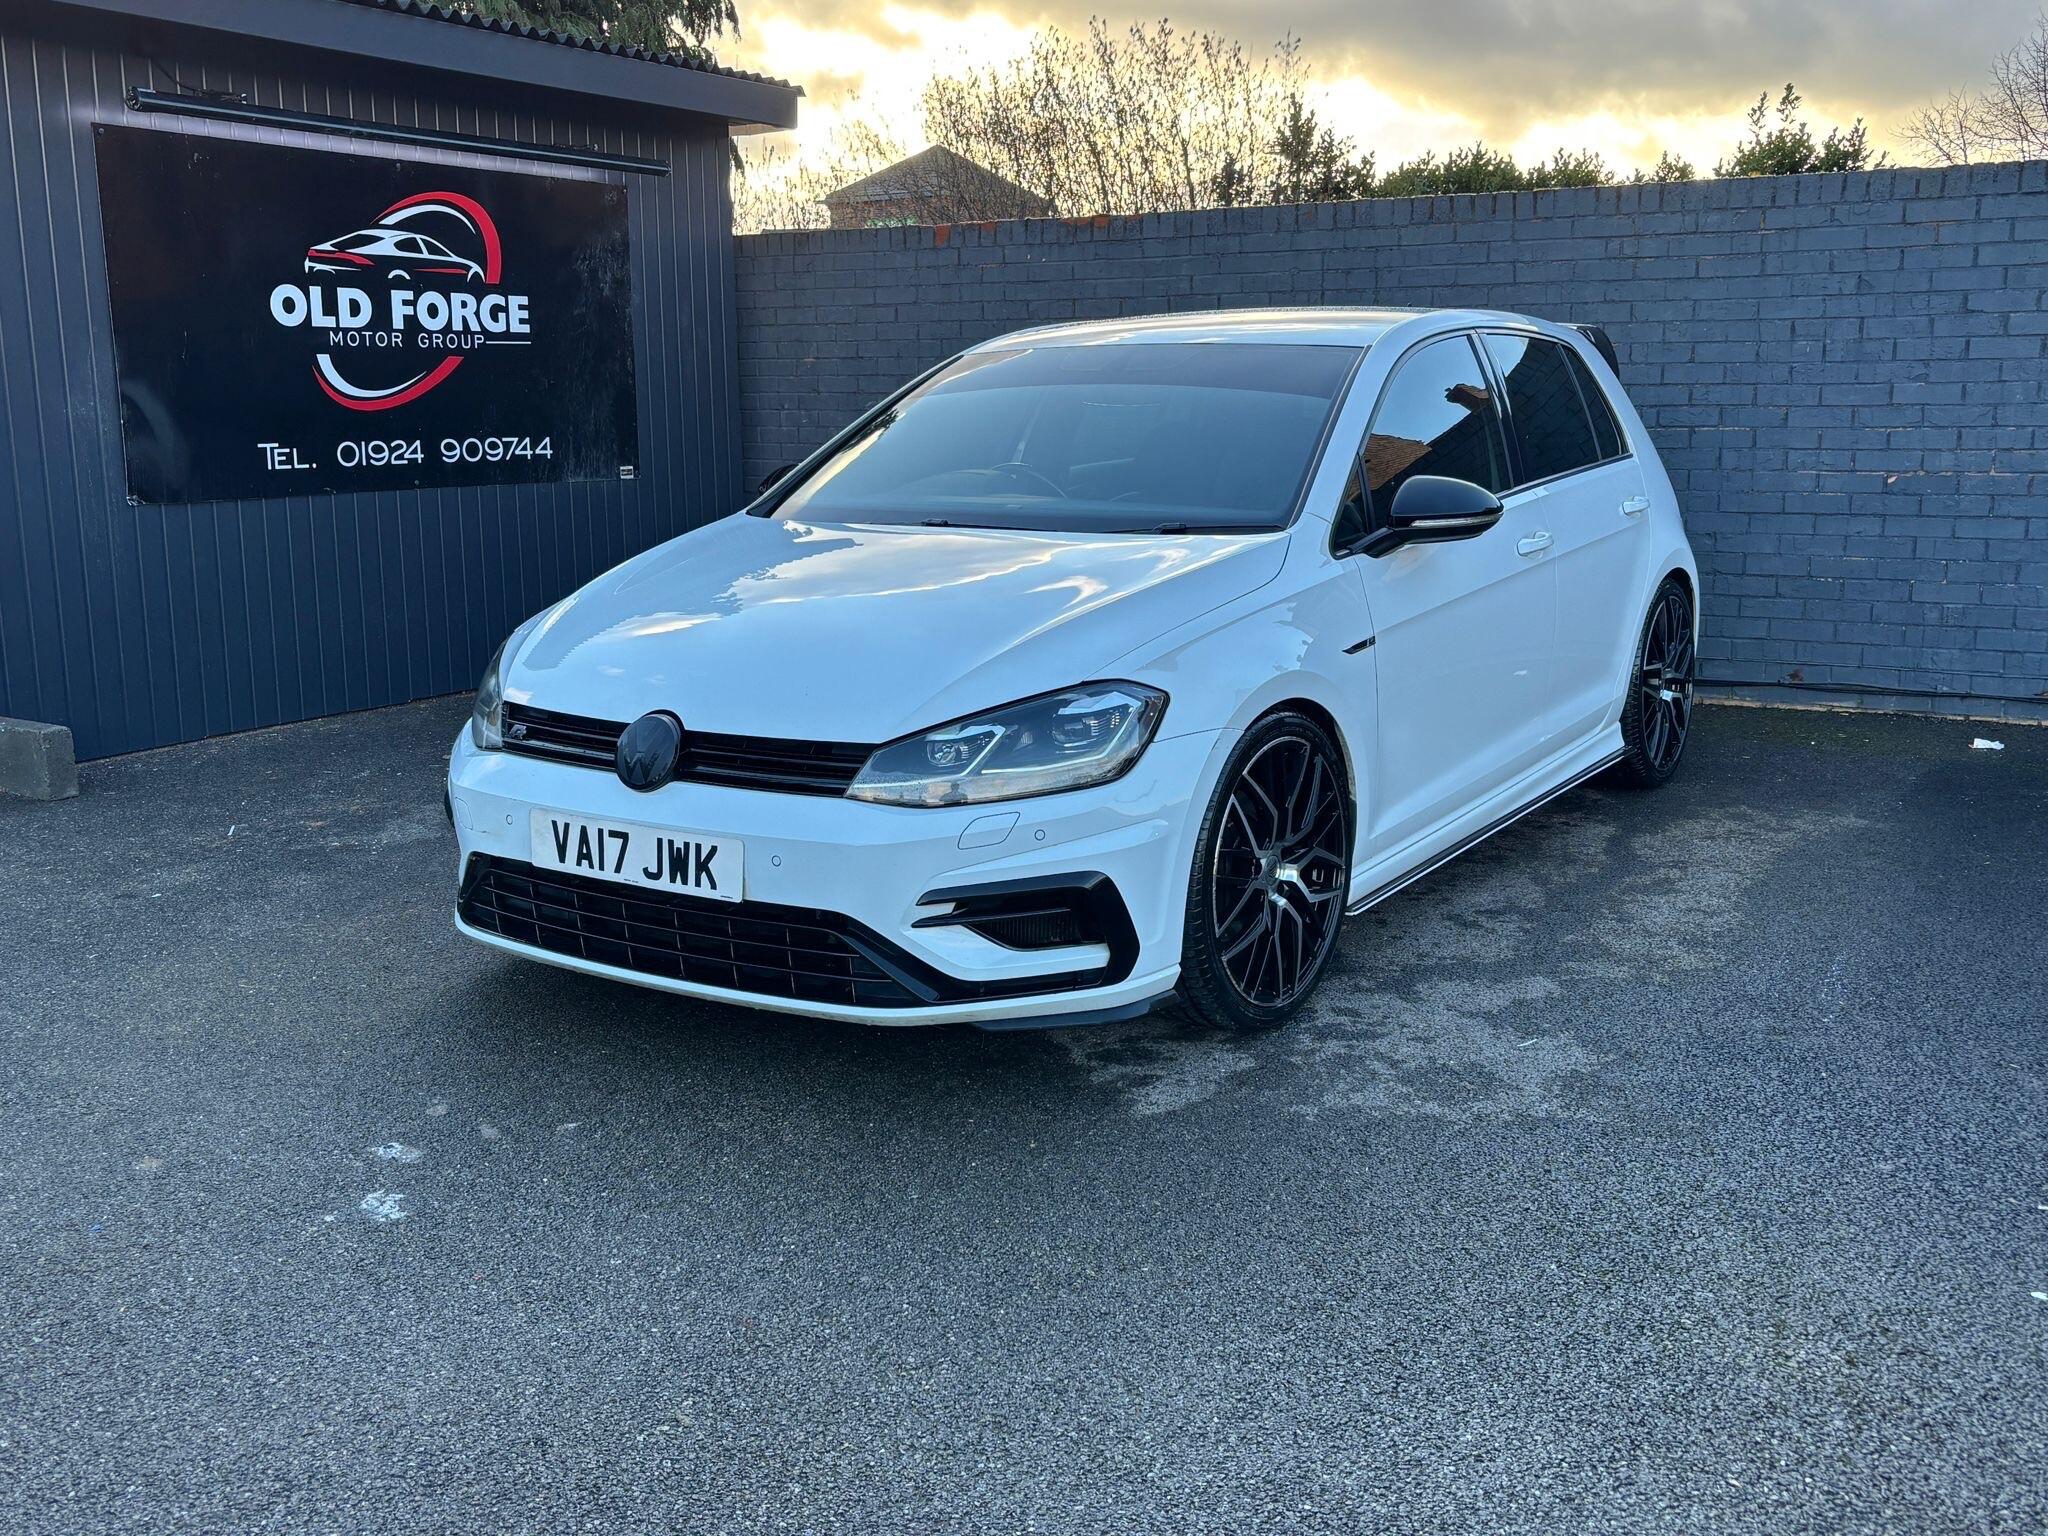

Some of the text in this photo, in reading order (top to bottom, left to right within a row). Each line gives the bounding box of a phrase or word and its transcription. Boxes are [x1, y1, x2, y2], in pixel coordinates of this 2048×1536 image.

[269, 283, 531, 334] OLD FORGE
[329, 330, 485, 349] MOTOR GROUP
[257, 436, 554, 471] TEL. 01924 909744
[551, 819, 718, 891] VA17 JWK
